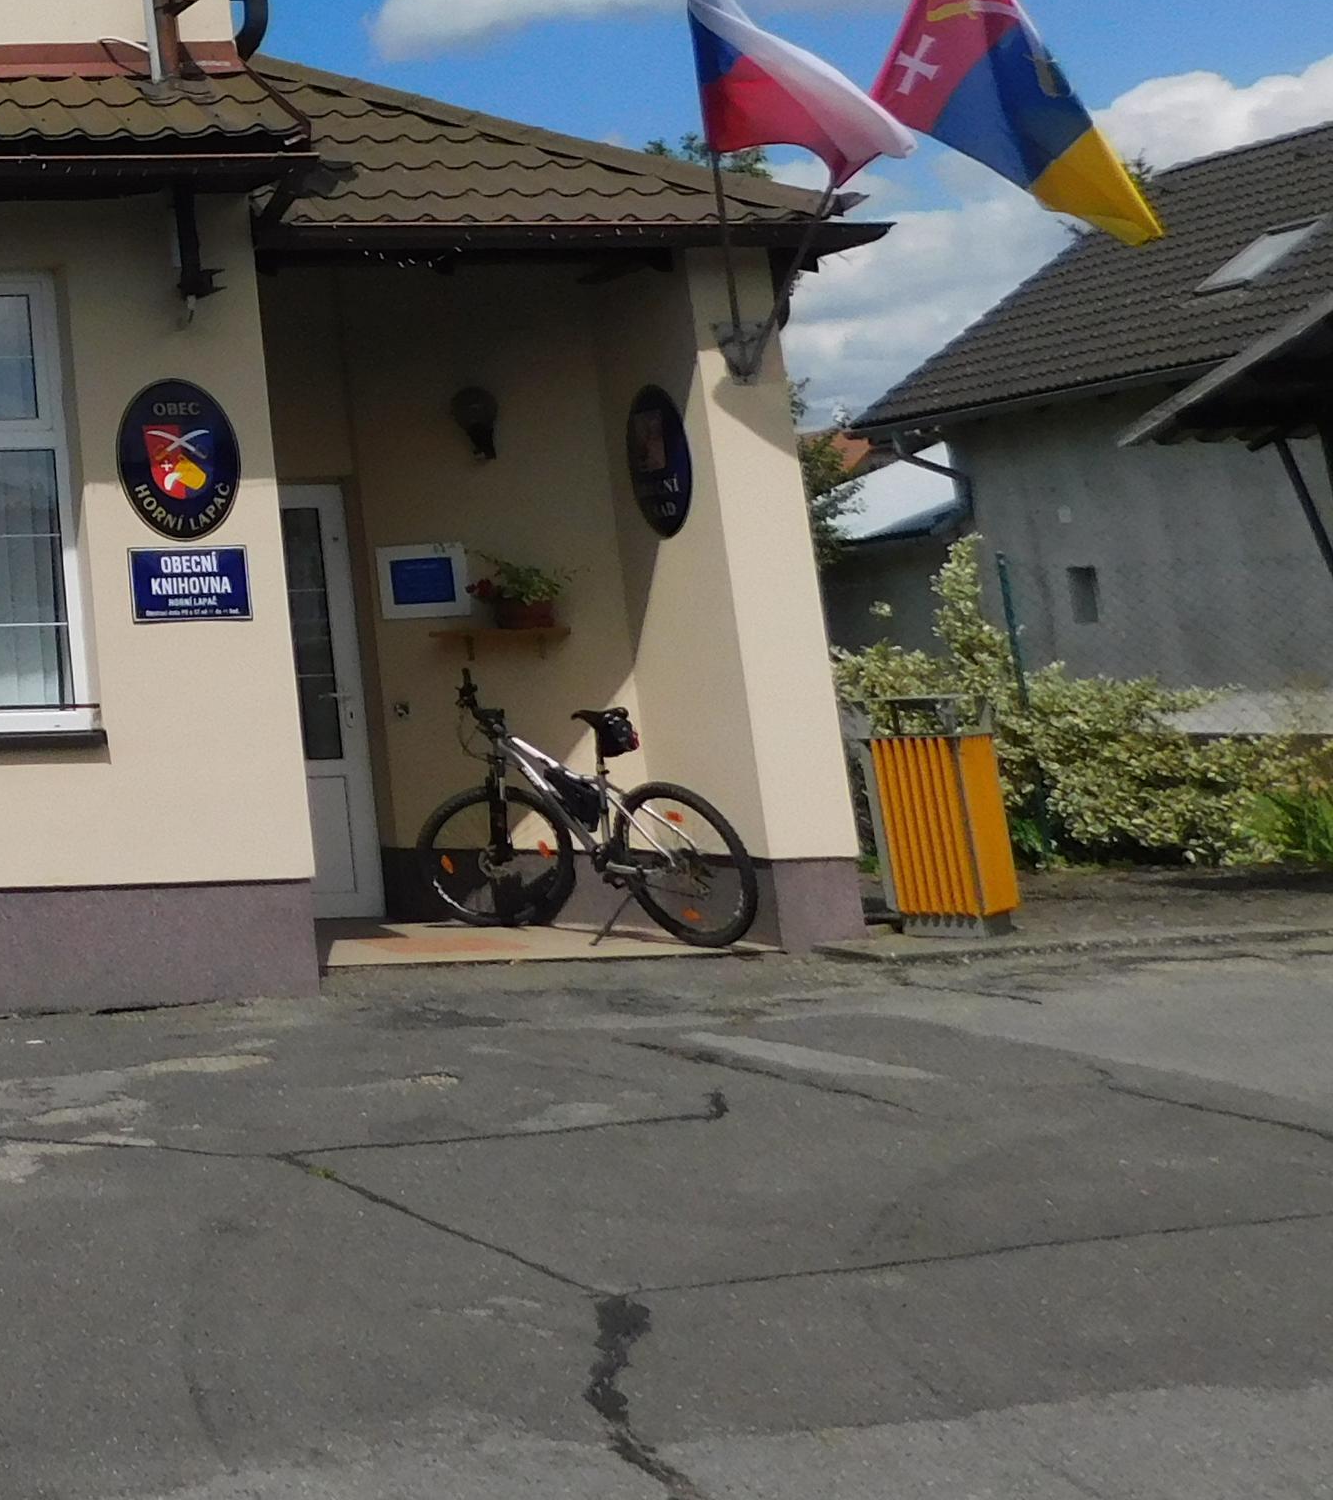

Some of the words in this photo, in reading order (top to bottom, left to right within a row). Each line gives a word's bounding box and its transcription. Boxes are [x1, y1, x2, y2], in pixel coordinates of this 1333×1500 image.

[153, 402, 201, 416] OBEC
[135, 484, 183, 531] HORNÍ
[190, 482, 231, 530] LAPAČ
[160, 551, 217, 573] OBECNÍ
[150, 576, 232, 596] KNIHOVNA
